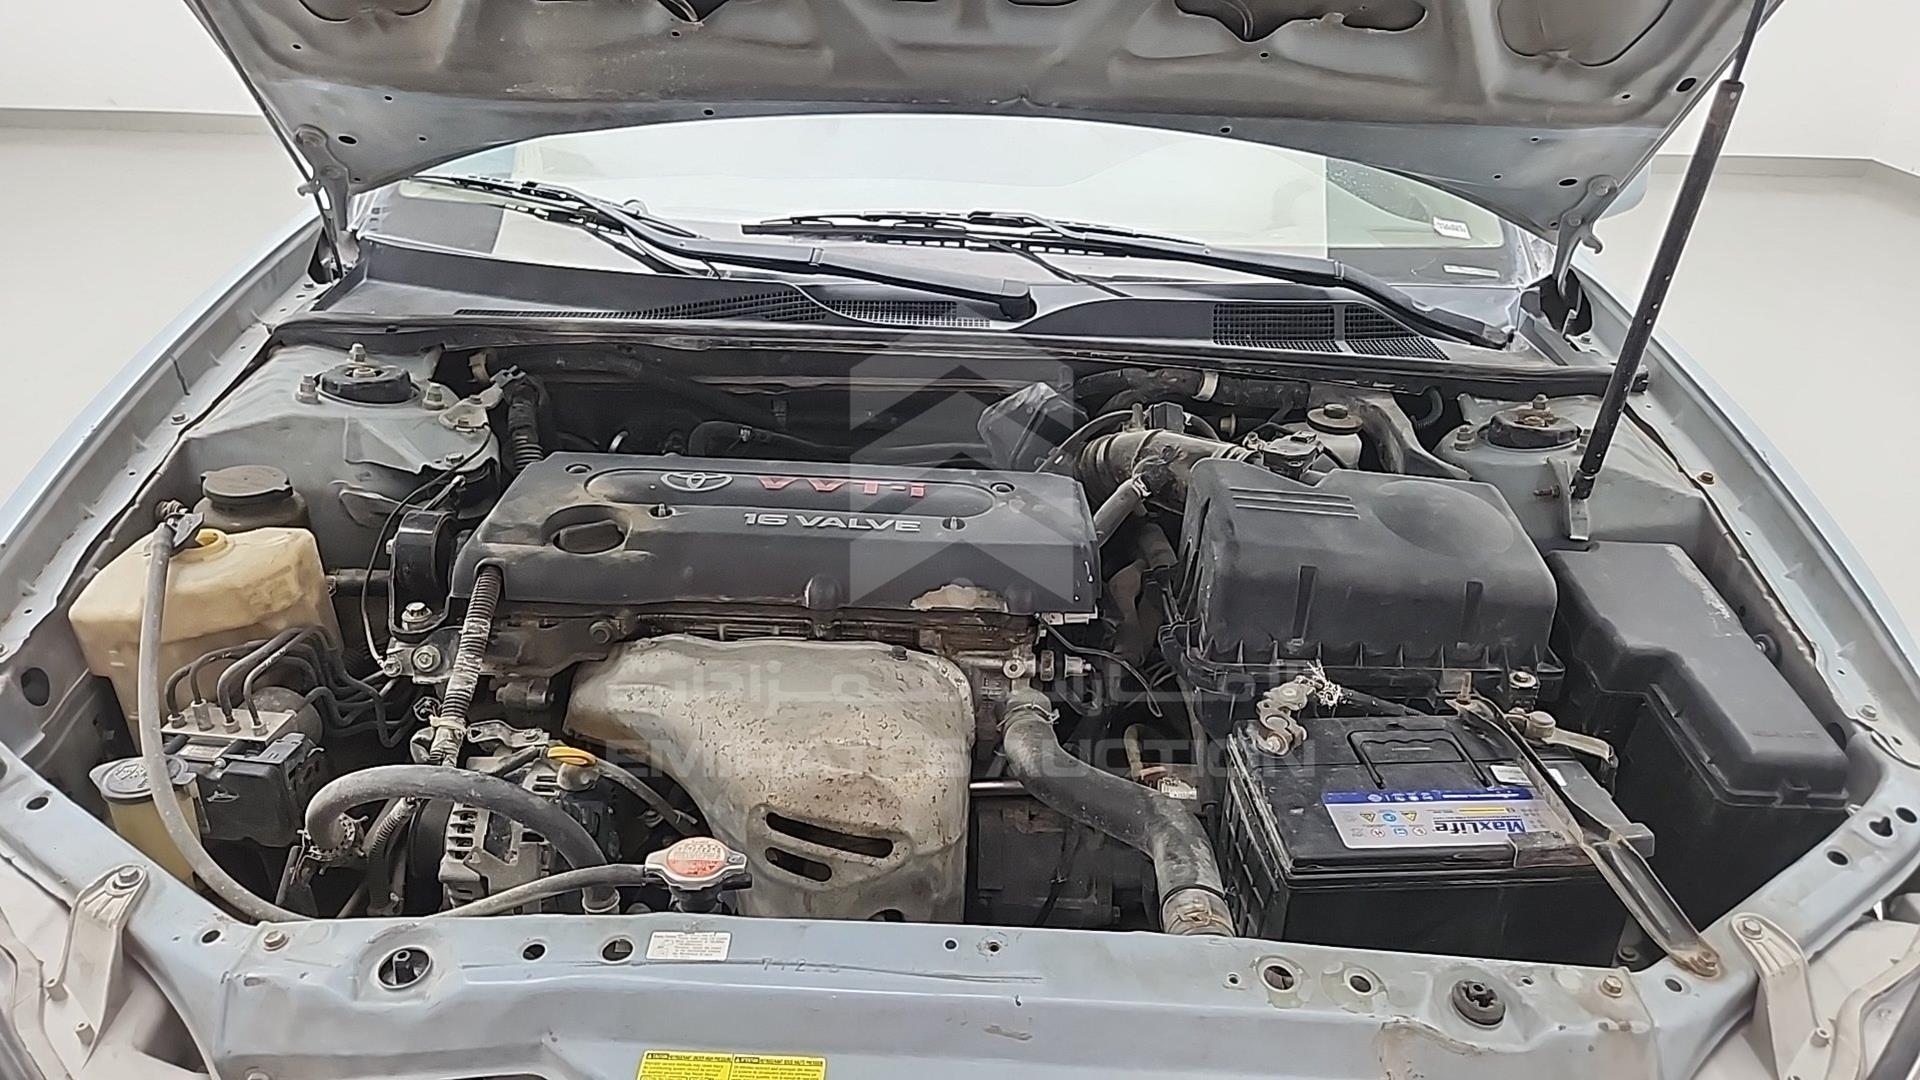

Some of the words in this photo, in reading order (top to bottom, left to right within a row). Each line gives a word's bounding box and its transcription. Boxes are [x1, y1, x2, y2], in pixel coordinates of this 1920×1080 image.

[743, 513, 788, 527] 16
[794, 514, 922, 533] VALVE
[1433, 820, 1527, 835] MaxLife
